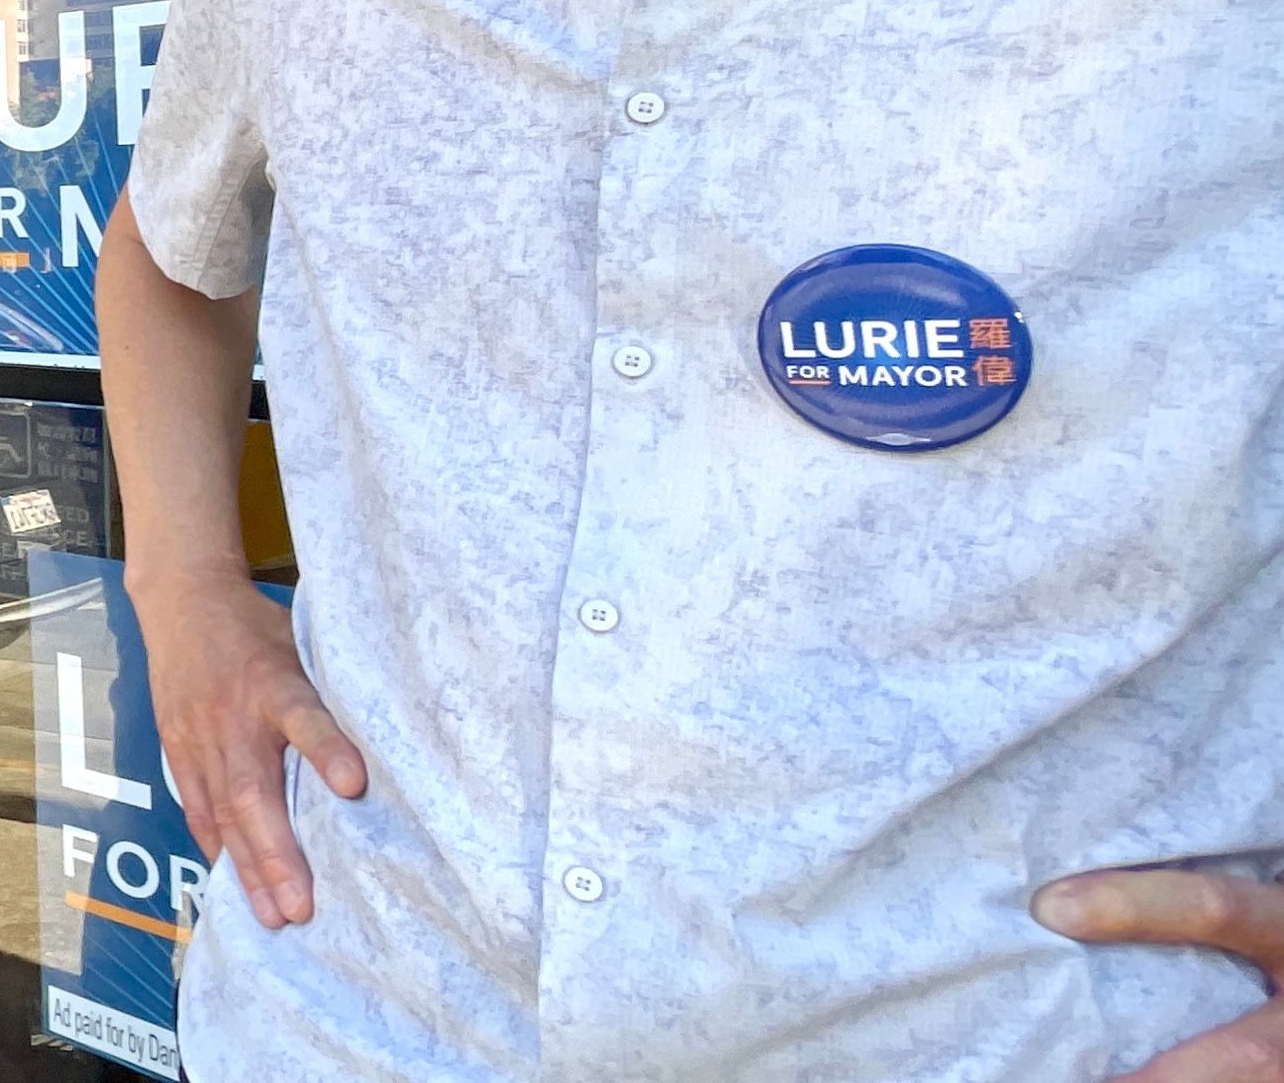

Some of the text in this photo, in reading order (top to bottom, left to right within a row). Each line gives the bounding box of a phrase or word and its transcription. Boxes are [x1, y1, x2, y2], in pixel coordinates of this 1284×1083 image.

[780, 318, 965, 359] LURIE
[786, 364, 968, 387] FOR MAYOR
[62, 823, 211, 912] FOR
[53, 998, 180, 1068] Ad paid for by Dan
